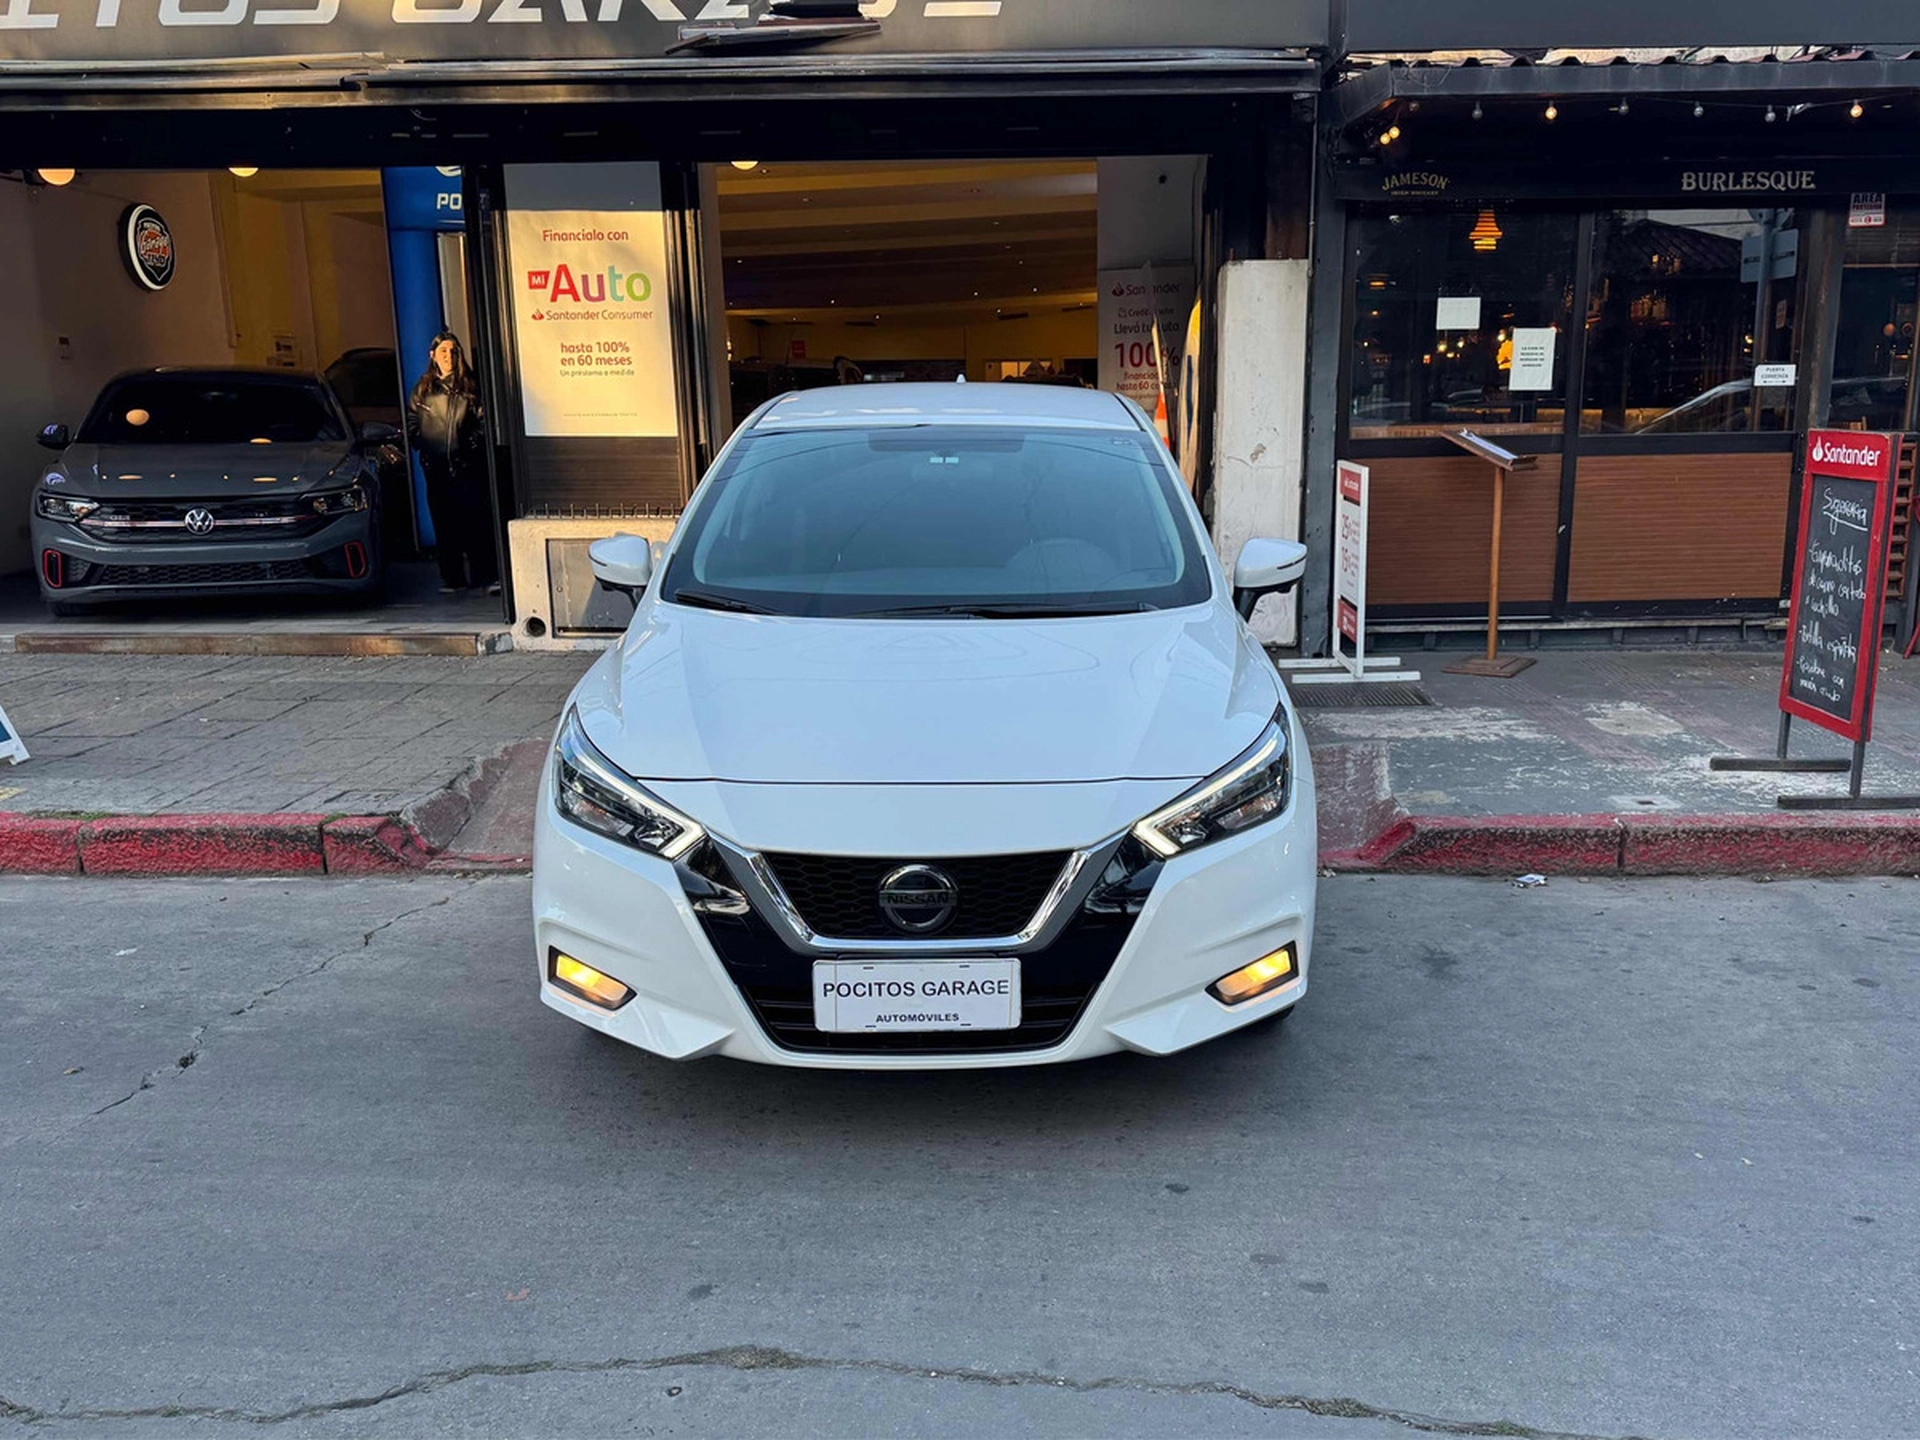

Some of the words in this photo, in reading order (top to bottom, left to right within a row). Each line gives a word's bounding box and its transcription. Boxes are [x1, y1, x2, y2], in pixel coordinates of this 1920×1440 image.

[1382, 172, 1448, 190] JAMESON
[1681, 171, 1816, 191] BURLESQUE
[607, 231, 629, 241] con
[550, 264, 651, 302] Auto
[545, 310, 600, 321] Santander
[601, 309, 653, 320] Consumer
[560, 342, 593, 353] hasta
[595, 341, 630, 353] 100%
[560, 357, 575, 366] en
[577, 354, 593, 366] 60
[595, 356, 632, 366] meses
[1140, 381, 1149, 391] 60
[1823, 442, 1881, 467] Santander
[887, 893, 948, 906] NISSAN
[823, 981, 915, 997] POCITOS
[921, 980, 1009, 997] GARAGE
[875, 1011, 960, 1023] AUTOMÓVILES
